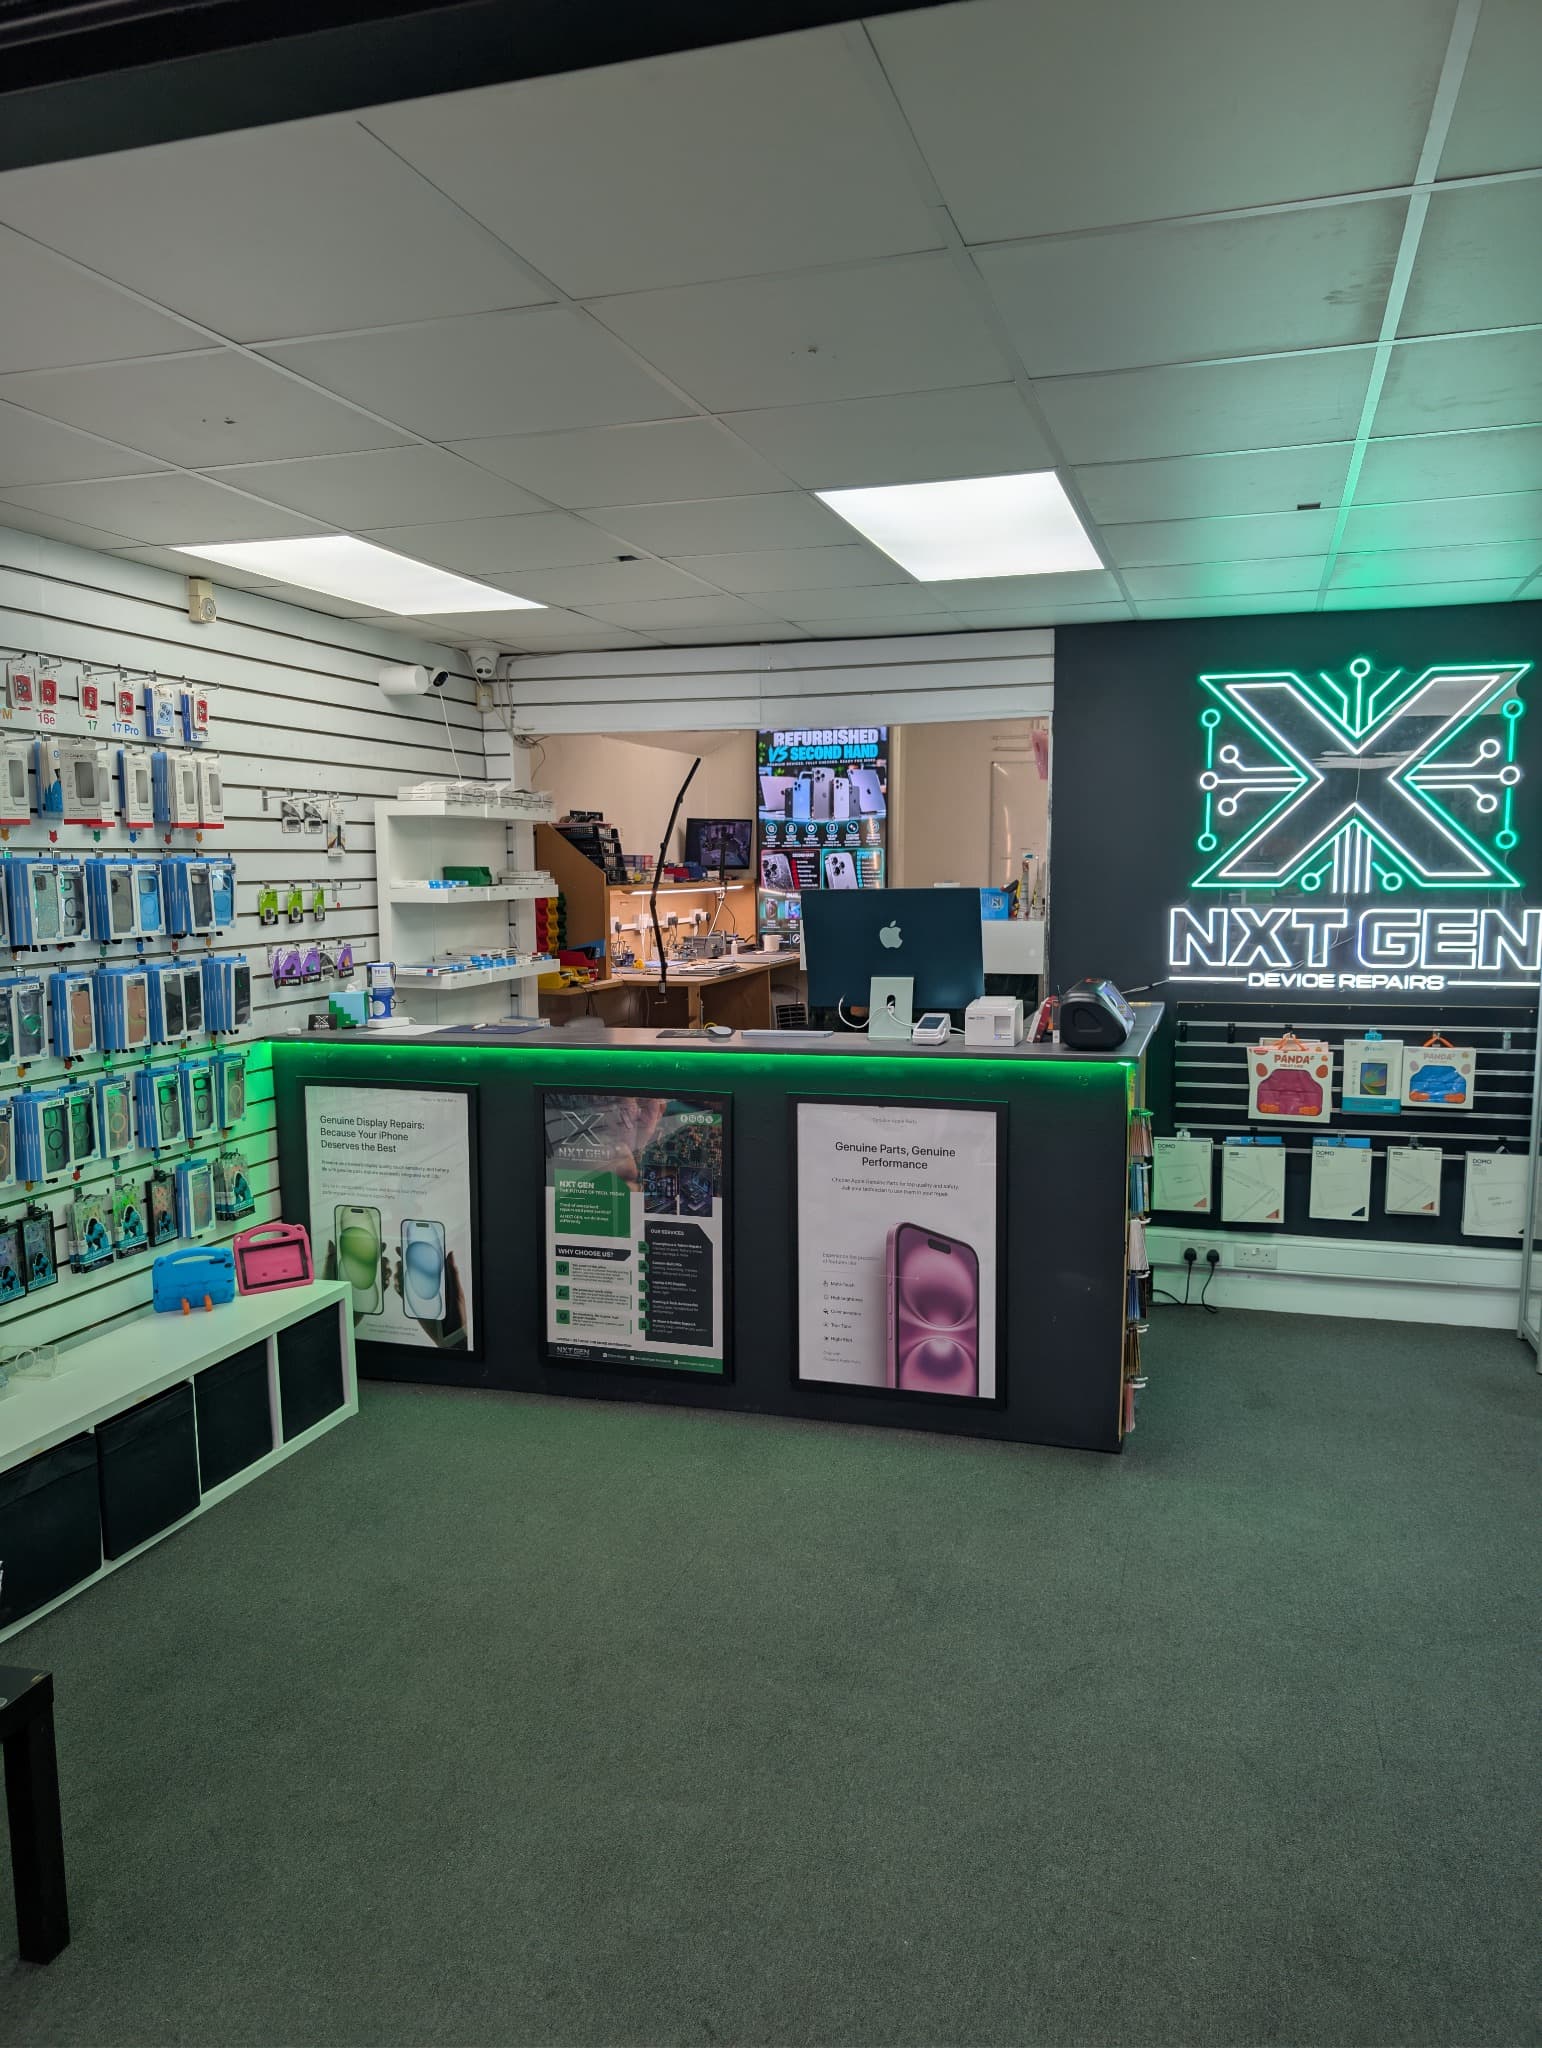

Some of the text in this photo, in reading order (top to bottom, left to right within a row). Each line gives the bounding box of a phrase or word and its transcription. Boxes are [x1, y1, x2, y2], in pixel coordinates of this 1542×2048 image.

[37, 712, 56, 725] 16e
[87, 719, 98, 731] 17
[111, 722, 140, 736] 17 Pro
[773, 728, 879, 747] REFURBISHED
[768, 744, 879, 763] VS SECOND HAND
[1168, 906, 1542, 971] NXT GEN
[1247, 972, 1446, 991] DEVICE REPAIRS
[320, 1115, 425, 1130] Genuine Display Repairs:
[320, 1127, 409, 1141] Because Your iPhone
[320, 1139, 397, 1153] Deserves the Best
[559, 1147, 611, 1159] NXT GEN
[835, 1141, 957, 1157] Genuine Parts, Genuine
[861, 1156, 929, 1170] Performance
[559, 1180, 595, 1189] NXT GEN
[558, 1248, 574, 1256] WHY
[574, 1249, 601, 1257] CHOOSE
[556, 1346, 574, 1355] NXT
